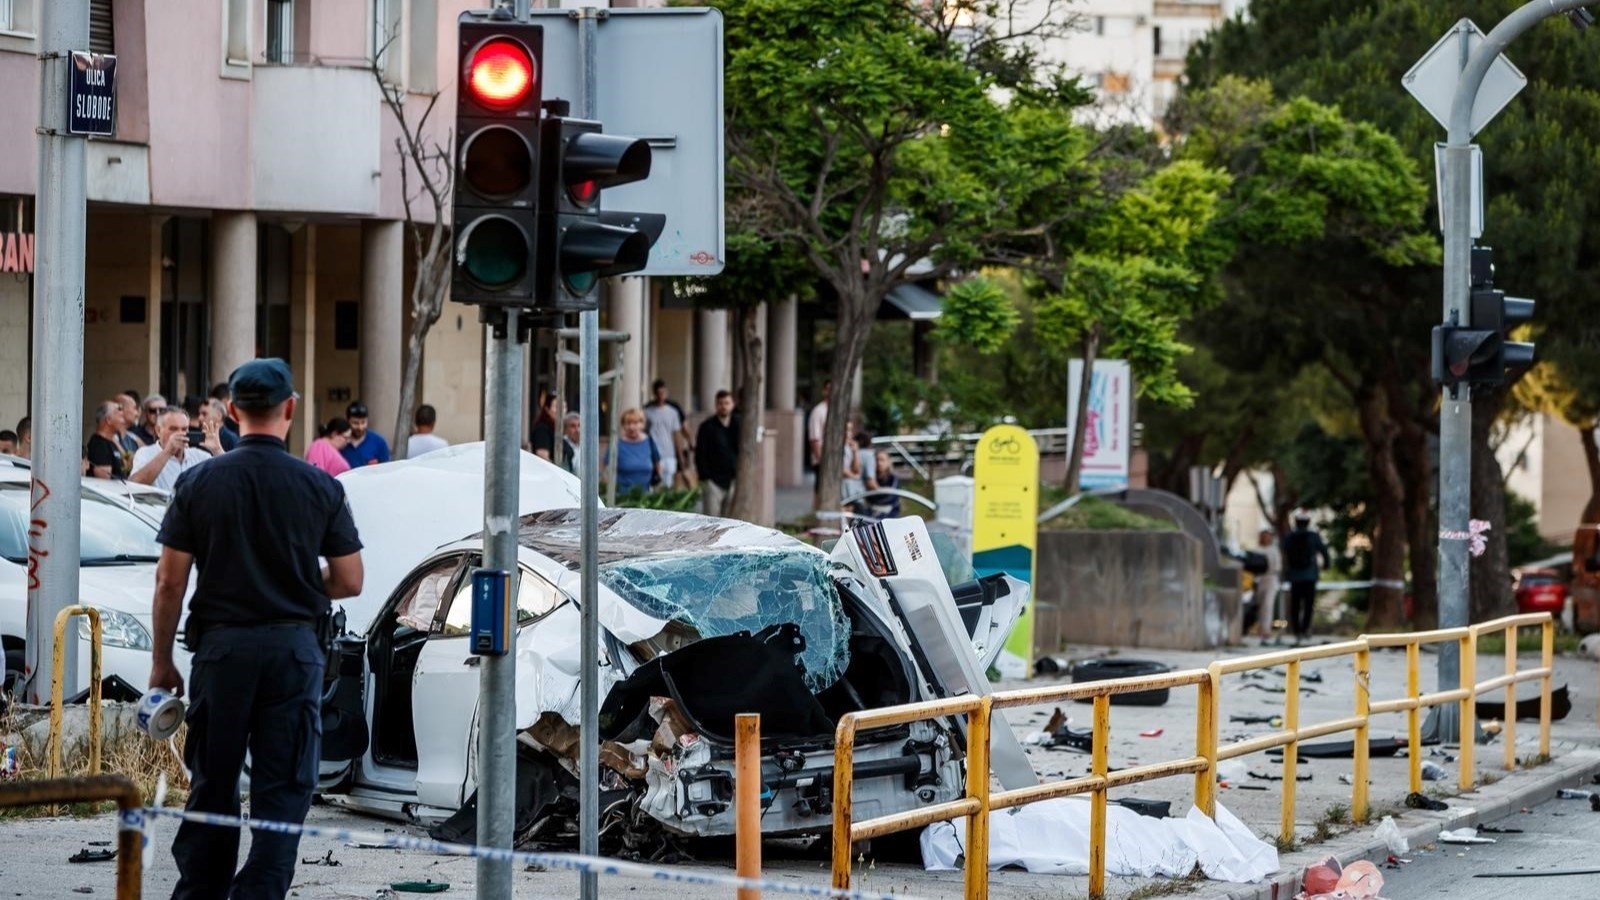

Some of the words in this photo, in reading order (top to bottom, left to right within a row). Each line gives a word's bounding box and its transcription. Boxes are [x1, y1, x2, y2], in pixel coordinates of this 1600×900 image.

[86, 68, 106, 87] ULICA
[76, 93, 112, 121] SLOBODE
[0, 232, 34, 273] AN
